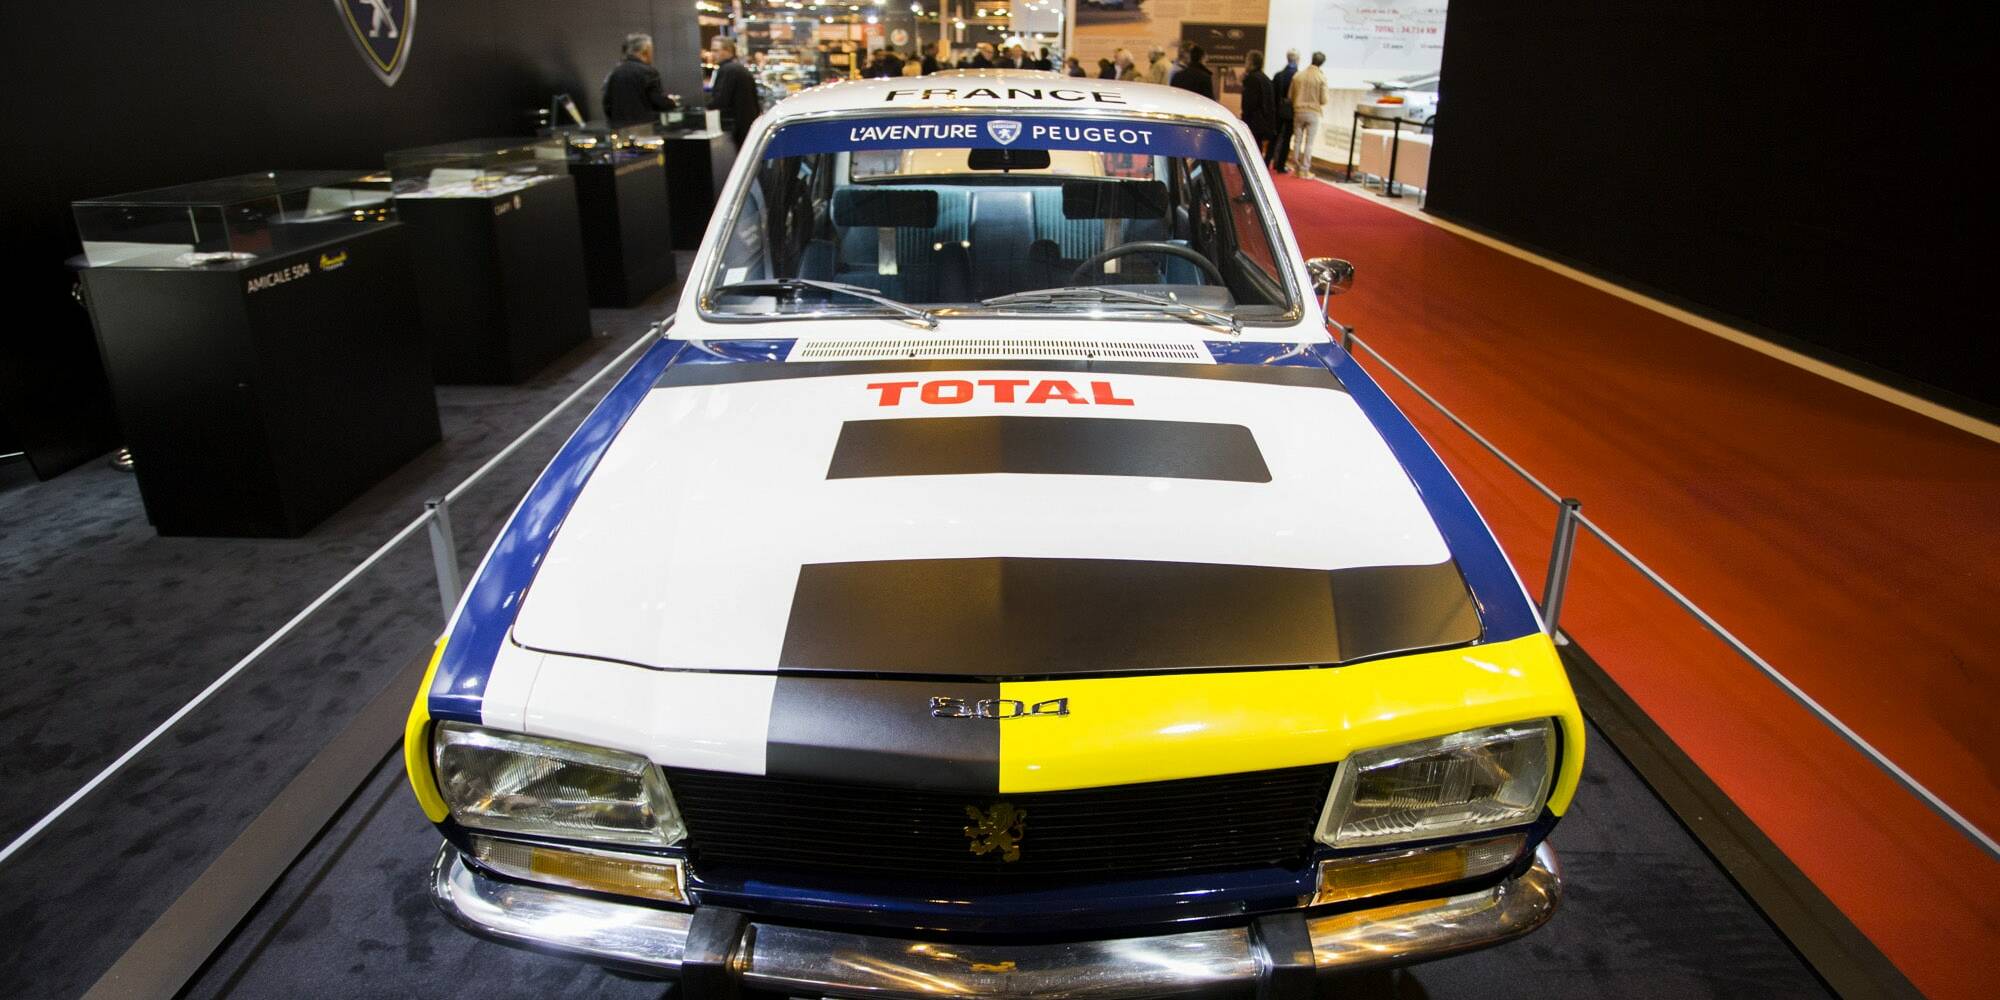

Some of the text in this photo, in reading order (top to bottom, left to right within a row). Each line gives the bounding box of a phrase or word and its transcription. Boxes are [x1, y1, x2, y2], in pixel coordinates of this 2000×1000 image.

[885, 88, 1127, 104] FRANCE
[850, 124, 1153, 145] L'AVENTURE PEUGEOT
[247, 262, 311, 294] AMICALE 504
[866, 379, 1135, 407] TOTAL
[930, 697, 1070, 719] 504
